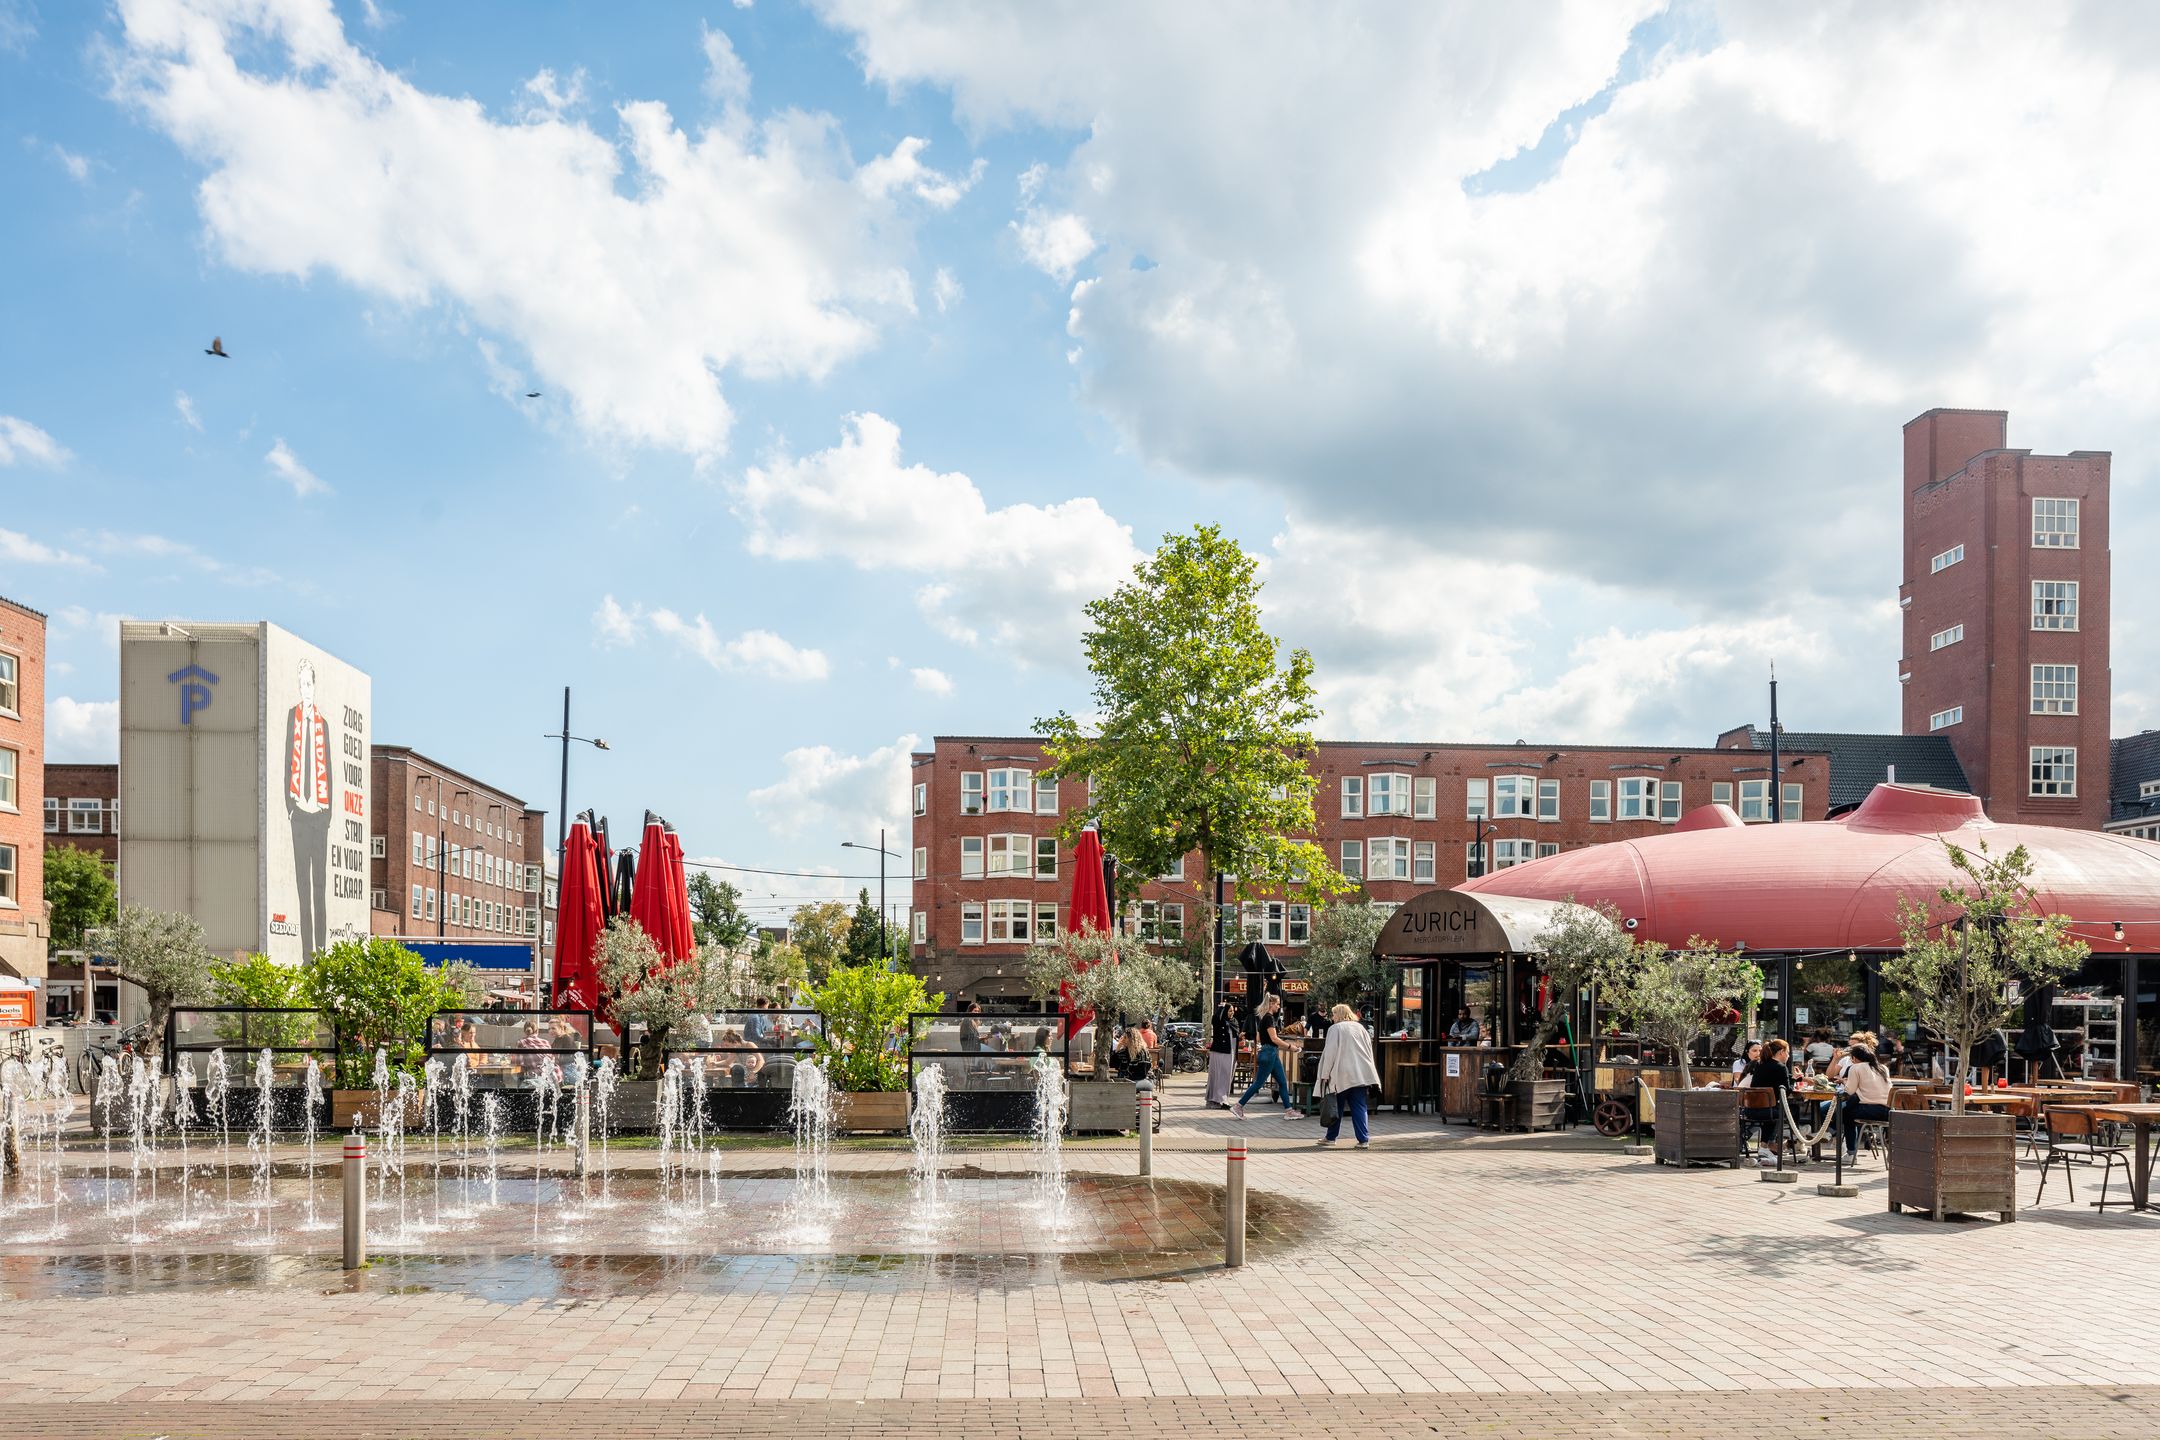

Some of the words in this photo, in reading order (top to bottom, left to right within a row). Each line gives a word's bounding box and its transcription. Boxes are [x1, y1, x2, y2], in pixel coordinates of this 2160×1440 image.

[181, 684, 212, 725] P
[343, 705, 363, 734] ZORG
[291, 718, 302, 794] AJAX
[343, 733, 363, 760] GOED
[343, 761, 363, 789] VOOR
[344, 790, 363, 816] ONZE
[345, 819, 363, 843] STAD
[331, 844, 341, 868] EN
[344, 847, 363, 872] VOOR
[334, 874, 363, 900] ELKAAR
[270, 921, 299, 936] SEEDORF
[1402, 910, 1476, 933] ZURICH
[1291, 982, 1309, 991] BAR
